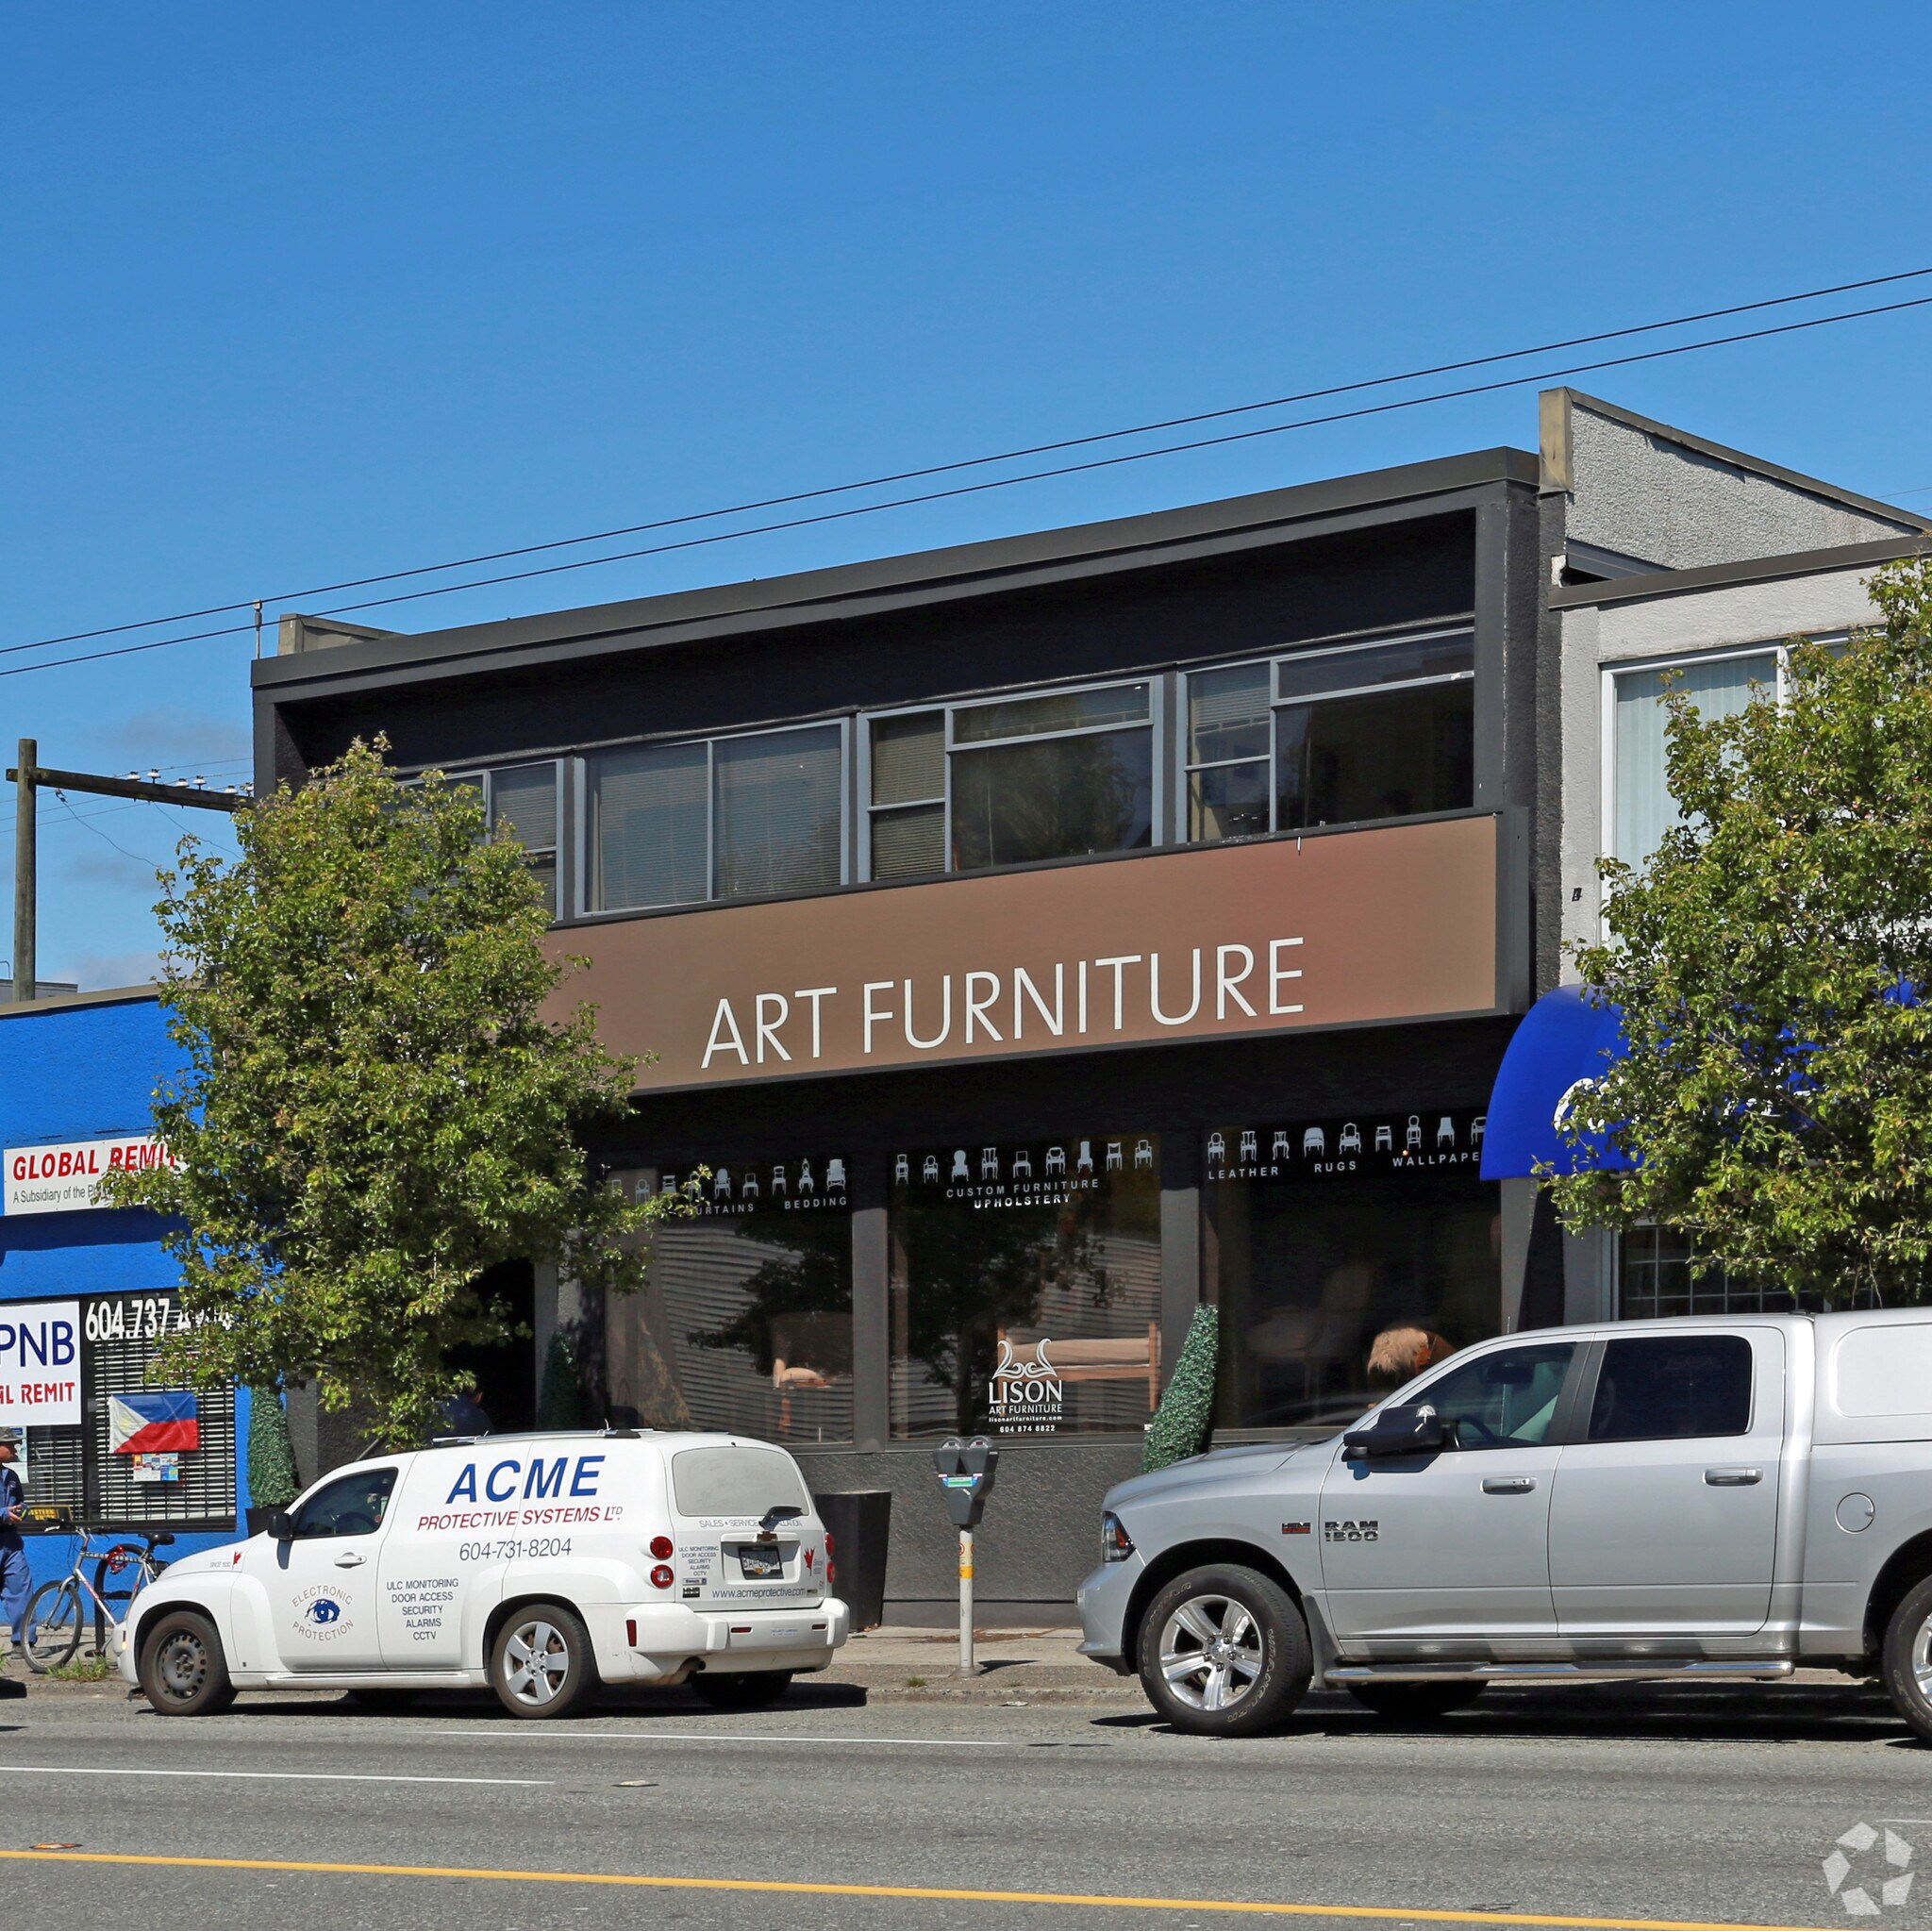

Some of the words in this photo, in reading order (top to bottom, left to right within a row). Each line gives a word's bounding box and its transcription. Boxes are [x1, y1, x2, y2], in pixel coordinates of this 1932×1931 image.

[700, 986, 838, 1069] ART
[863, 937, 1305, 1054] FURNITURE
[13, 1149, 100, 1180] GLOBAL
[1208, 1166, 1279, 1180] LEATHER
[1314, 1160, 1357, 1174] RUGS
[1392, 1152, 1480, 1168] WALLPAPE
[13, 1190, 20, 1204] A
[21, 1187, 61, 1204] Subsidiary
[63, 1187, 72, 1199] of
[74, 1186, 86, 1199] the
[946, 1185, 1006, 1199] CUSTOM
[1013, 1178, 1100, 1194] FURNITURE
[695, 1203, 755, 1216] URTAINS
[784, 1196, 847, 1210] BEDDING
[974, 1193, 1071, 1209] UPHOLSTERY
[0, 1321, 75, 1367] PNB
[21, 1382, 75, 1406] REMIT
[988, 1379, 1062, 1405] LISON
[989, 1406, 1007, 1415] ART
[1008, 1404, 1062, 1414] FURNITURE
[999, 1424, 1014, 1433] 604
[1017, 1424, 1032, 1433] 874
[445, 1455, 606, 1505] ACME
[417, 1510, 519, 1531] PROTECTIVE
[522, 1506, 601, 1525] SYSTEMS
[699, 1520, 724, 1528] SALES
[729, 1519, 758, 1527] SERVICE
[1324, 1520, 1378, 1530] RAM
[1324, 1531, 1378, 1541] 1500
[459, 1538, 572, 1561] 604-731-8204
[387, 1579, 404, 1590] ULC
[406, 1577, 459, 1590] MONITORING
[291, 1585, 354, 1608] ELECTRONIC
[391, 1592, 416, 1603] DOOR
[419, 1591, 454, 1602] ACCESS
[712, 1588, 806, 1600] www.acmeprotective.com
[402, 1605, 443, 1616] SECURITY
[291, 1619, 355, 1641] PROTECTION
[406, 1618, 441, 1628] ALARMS
[413, 1631, 437, 1640] CCTV
